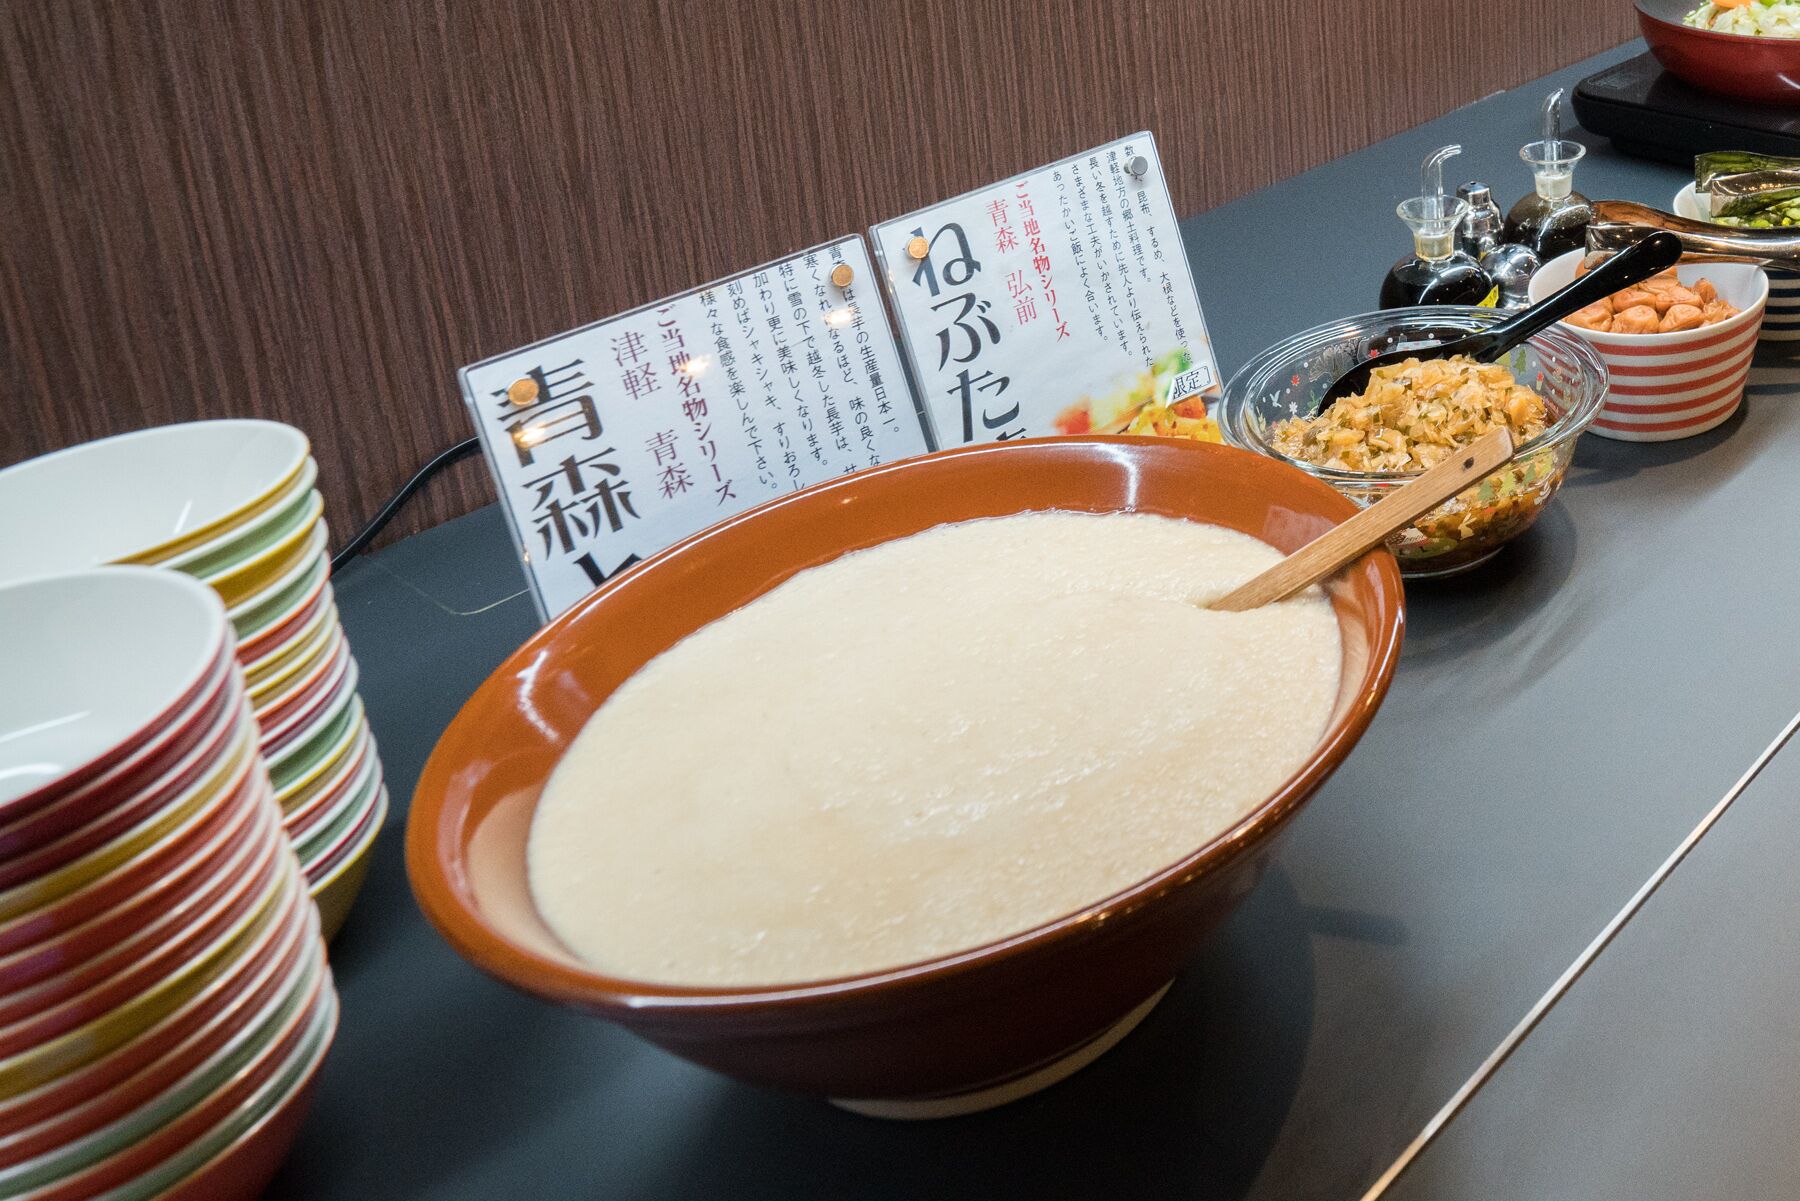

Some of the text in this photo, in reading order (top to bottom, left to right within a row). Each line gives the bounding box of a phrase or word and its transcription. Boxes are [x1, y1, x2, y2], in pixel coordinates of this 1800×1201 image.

[986, 199, 1038, 325] 青森 弘前
[1014, 181, 1070, 342] ご当地名物シリーズ
[1052, 171, 1109, 341] あったかいご飯によく合います。
[1106, 151, 1153, 283] 津軽地方の郷土料理です。
[1124, 145, 1194, 364] 数、昆布、するめ、大根などを使った、
[610, 330, 695, 500] 津軽 青森
[656, 304, 738, 507] ご当地名物シリーズ
[699, 291, 778, 489] 様々な食感を楽しんで下さい。
[803, 252, 880, 467] 寒くなれなるほど、味の良くな
[902, 221, 1028, 443] ねぶた
